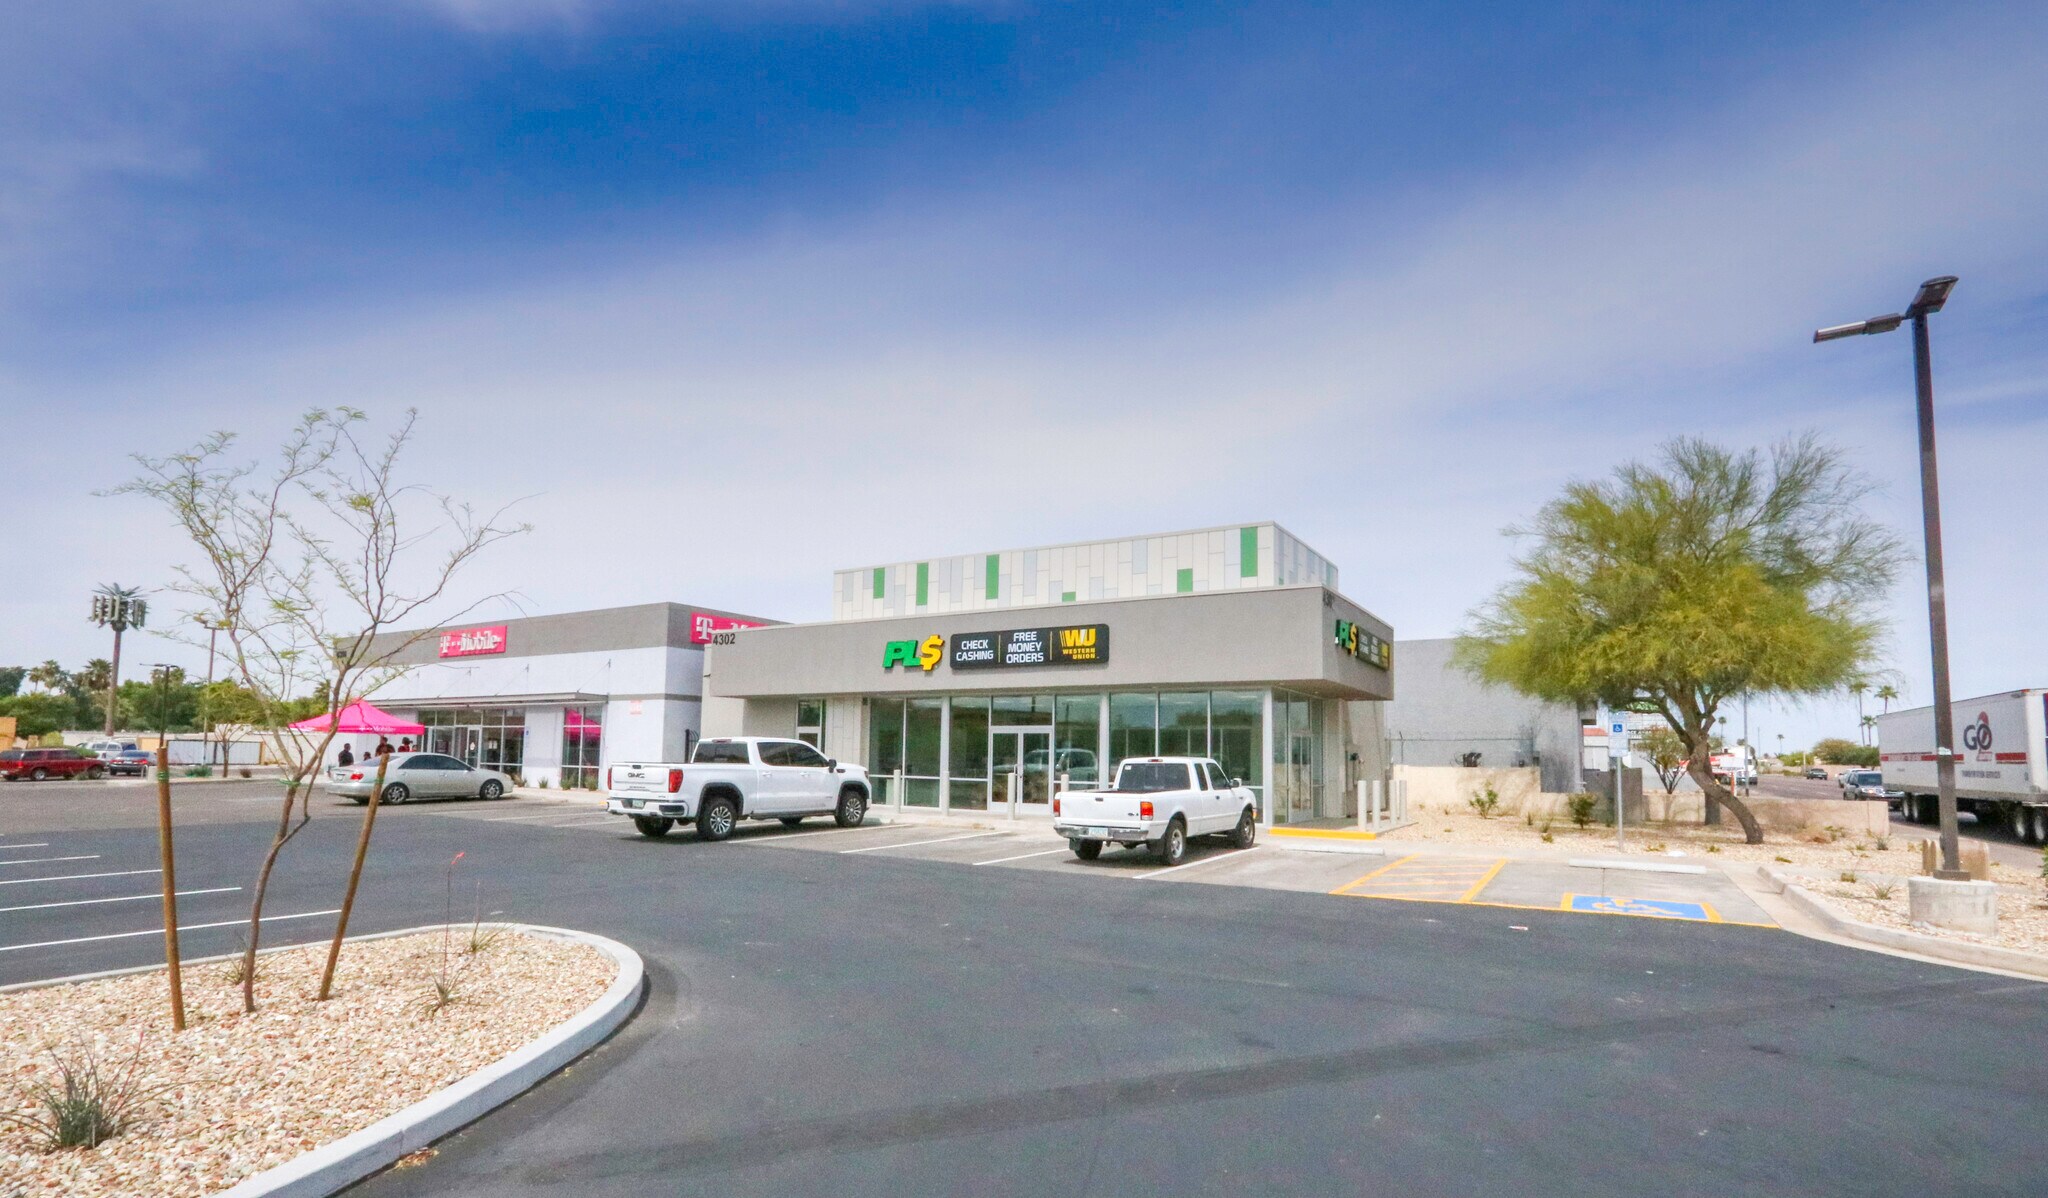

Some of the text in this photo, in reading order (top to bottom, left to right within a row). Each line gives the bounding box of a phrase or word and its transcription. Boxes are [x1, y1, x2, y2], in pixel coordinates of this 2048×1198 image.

[712, 633, 736, 645] 4302
[1013, 631, 1037, 642] FREE
[961, 639, 989, 650] CHECK
[1007, 642, 1042, 653] MONEY
[882, 634, 945, 671] PL$
[956, 650, 994, 661] CASHING
[1006, 653, 1044, 664] ORDERS
